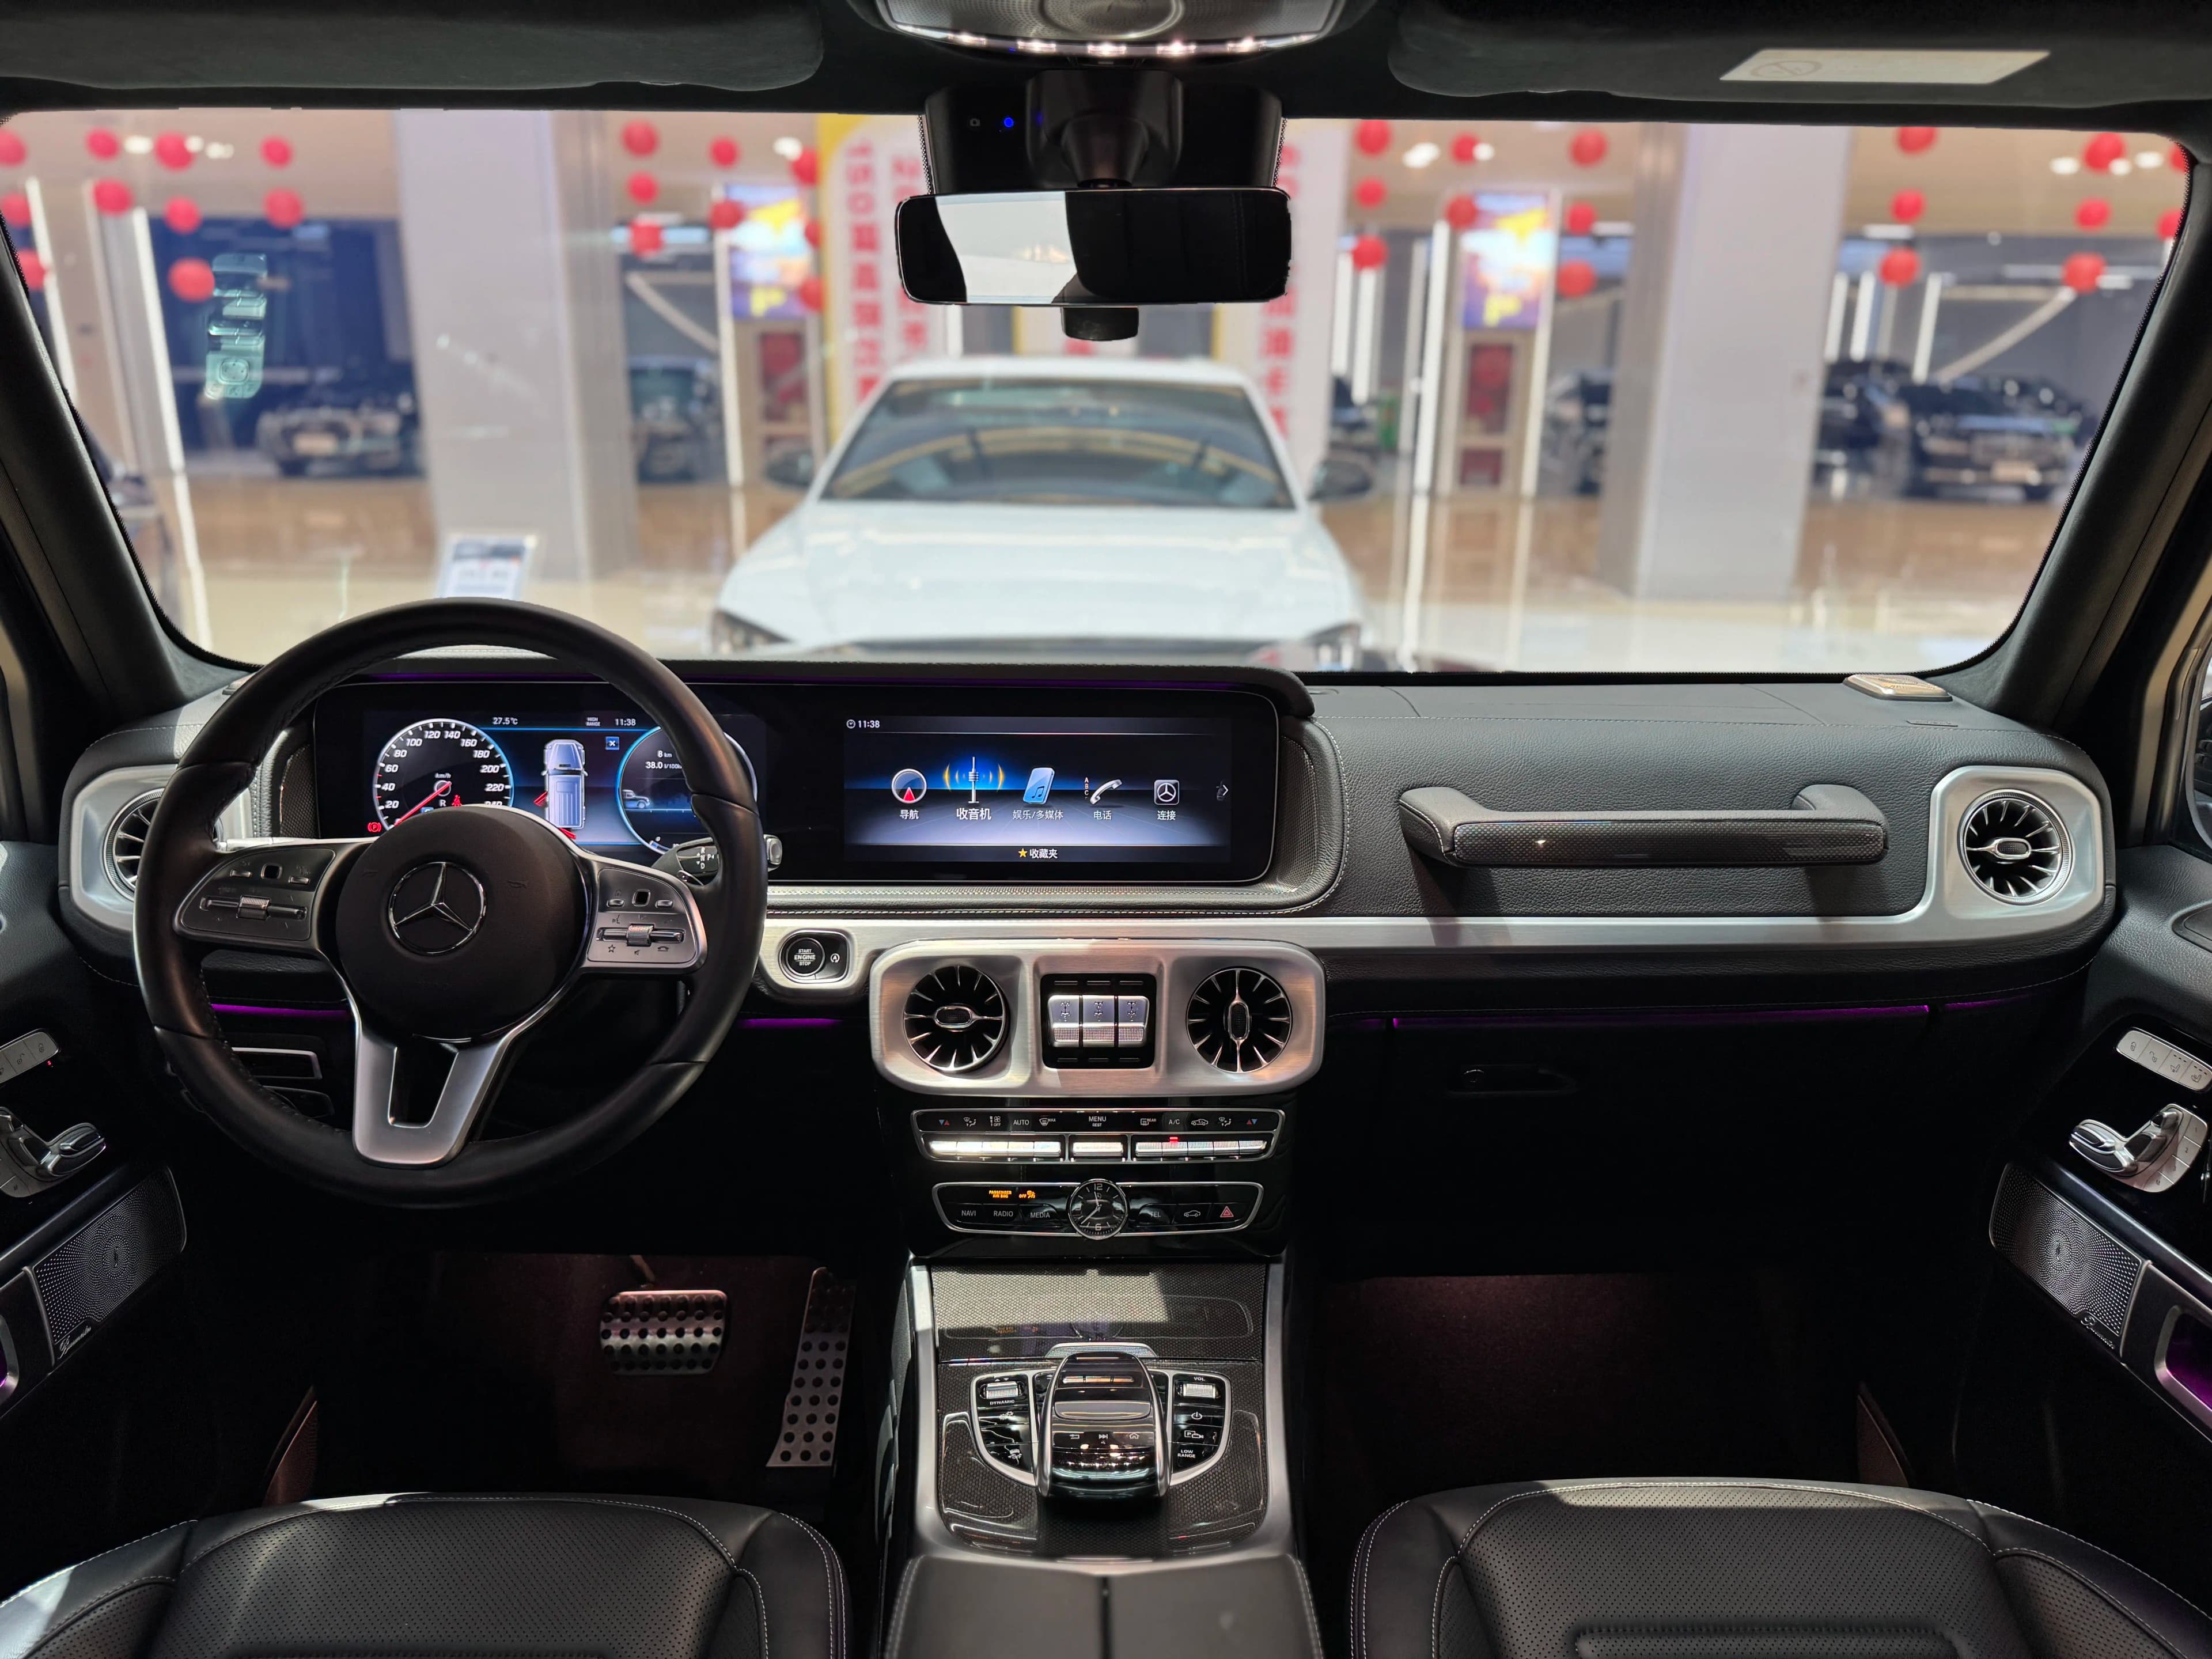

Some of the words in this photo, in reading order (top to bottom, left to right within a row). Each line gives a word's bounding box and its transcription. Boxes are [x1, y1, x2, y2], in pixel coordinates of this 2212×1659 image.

[858, 720, 880, 728] 11:38
[424, 730, 441, 739] 120
[444, 730, 461, 739] 140
[406, 738, 422, 747] 100
[461, 738, 478, 747] 160
[473, 750, 490, 758] 180
[657, 750, 663, 758] 8
[384, 764, 399, 772] 60
[480, 765, 499, 773] 200
[645, 761, 663, 769] 38.0
[381, 783, 395, 791] 40
[484, 783, 504, 791] 220
[900, 809, 919, 820] 导航
[956, 808, 991, 820] 收音机
[1013, 810, 1063, 820] 娱乐/多媒体
[1094, 810, 1112, 820] 电话
[1157, 810, 1176, 820] 连接
[1029, 849, 1058, 859] 收藏夹
